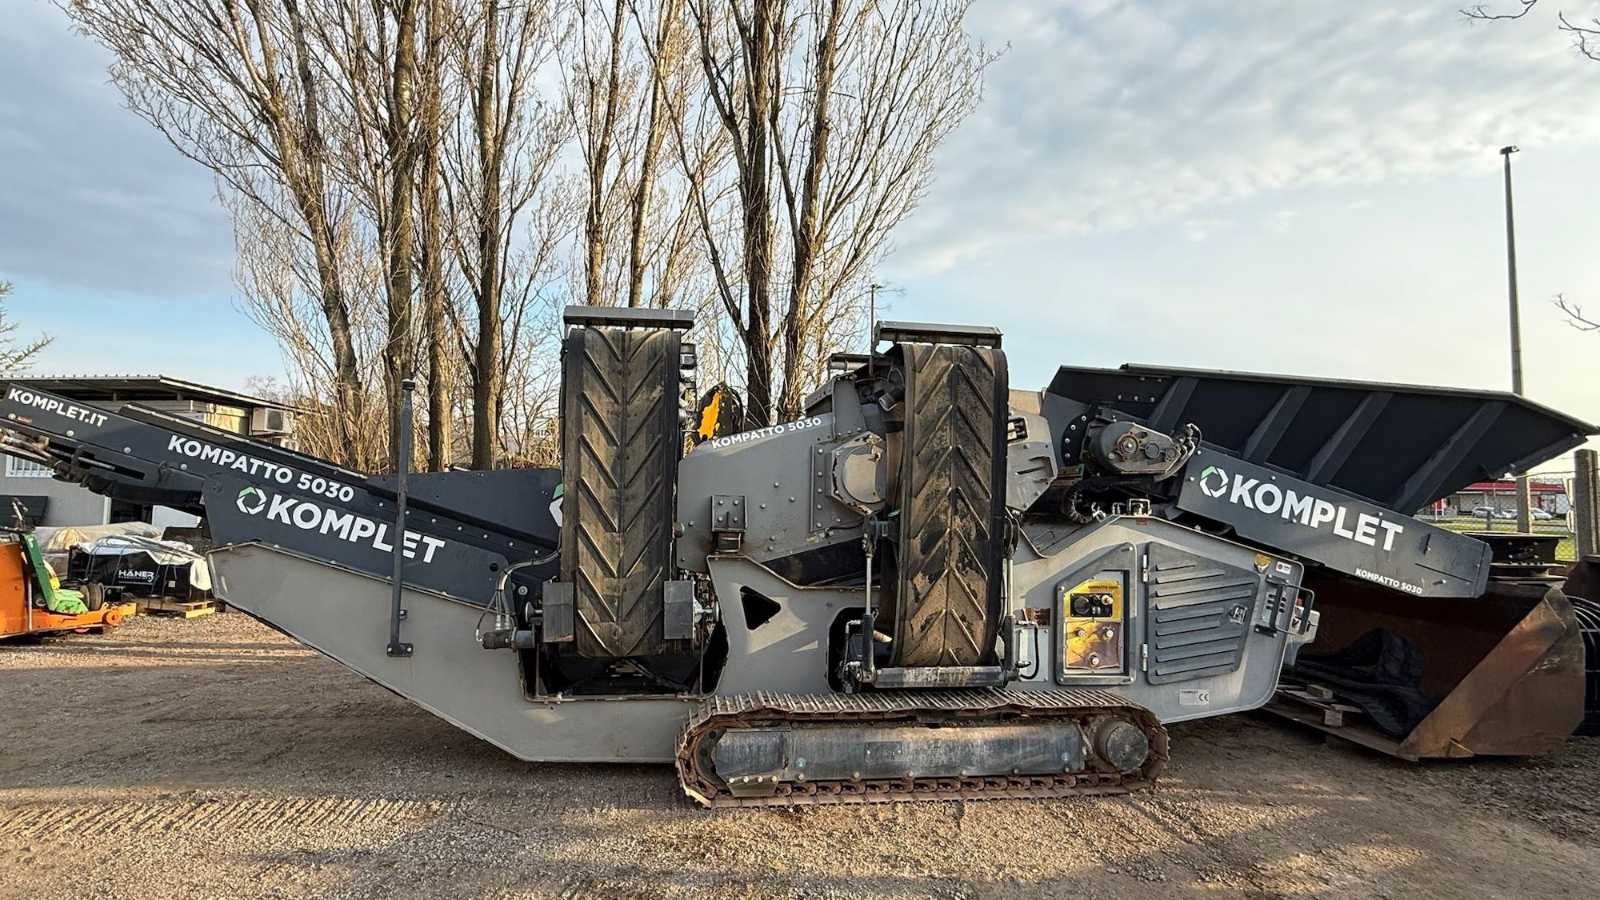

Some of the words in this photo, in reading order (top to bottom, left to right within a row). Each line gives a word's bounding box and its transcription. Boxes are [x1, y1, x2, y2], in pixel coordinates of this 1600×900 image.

[8, 388, 107, 427] KOMPLET.IT
[712, 425, 784, 448] KOMPATTO
[788, 417, 821, 431] 5030
[168, 435, 293, 484] KOMPATTO
[297, 473, 354, 503] 5030
[266, 493, 446, 563] KOMPLET
[1229, 474, 1403, 551] KOMPLET
[1355, 567, 1399, 588] KOMPATTO
[1401, 581, 1423, 594] 5030
